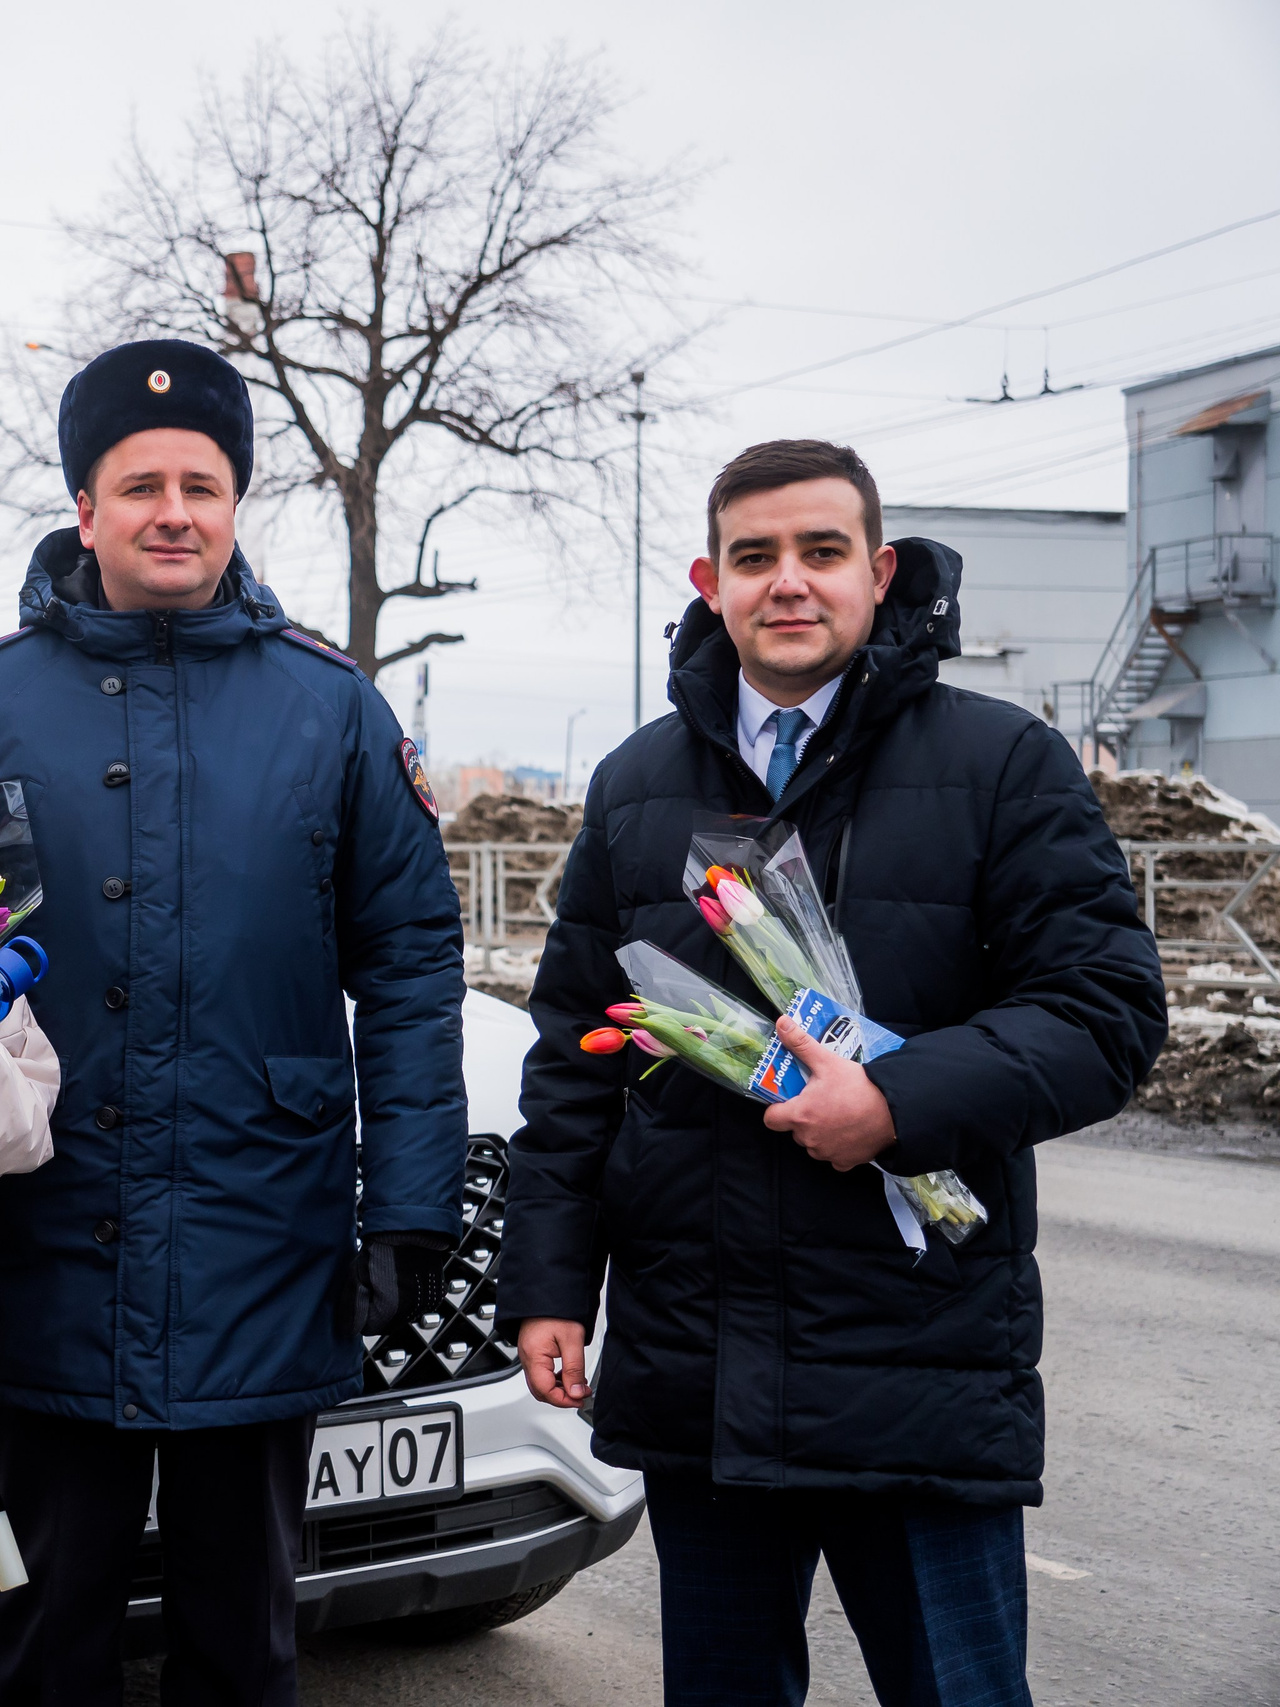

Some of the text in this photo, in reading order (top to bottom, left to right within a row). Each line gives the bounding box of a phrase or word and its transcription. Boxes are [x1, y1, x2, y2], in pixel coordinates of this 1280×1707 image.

[809, 1000, 823, 1015] На
[800, 1016, 813, 1032] стр
[388, 1421, 451, 1488] 07
